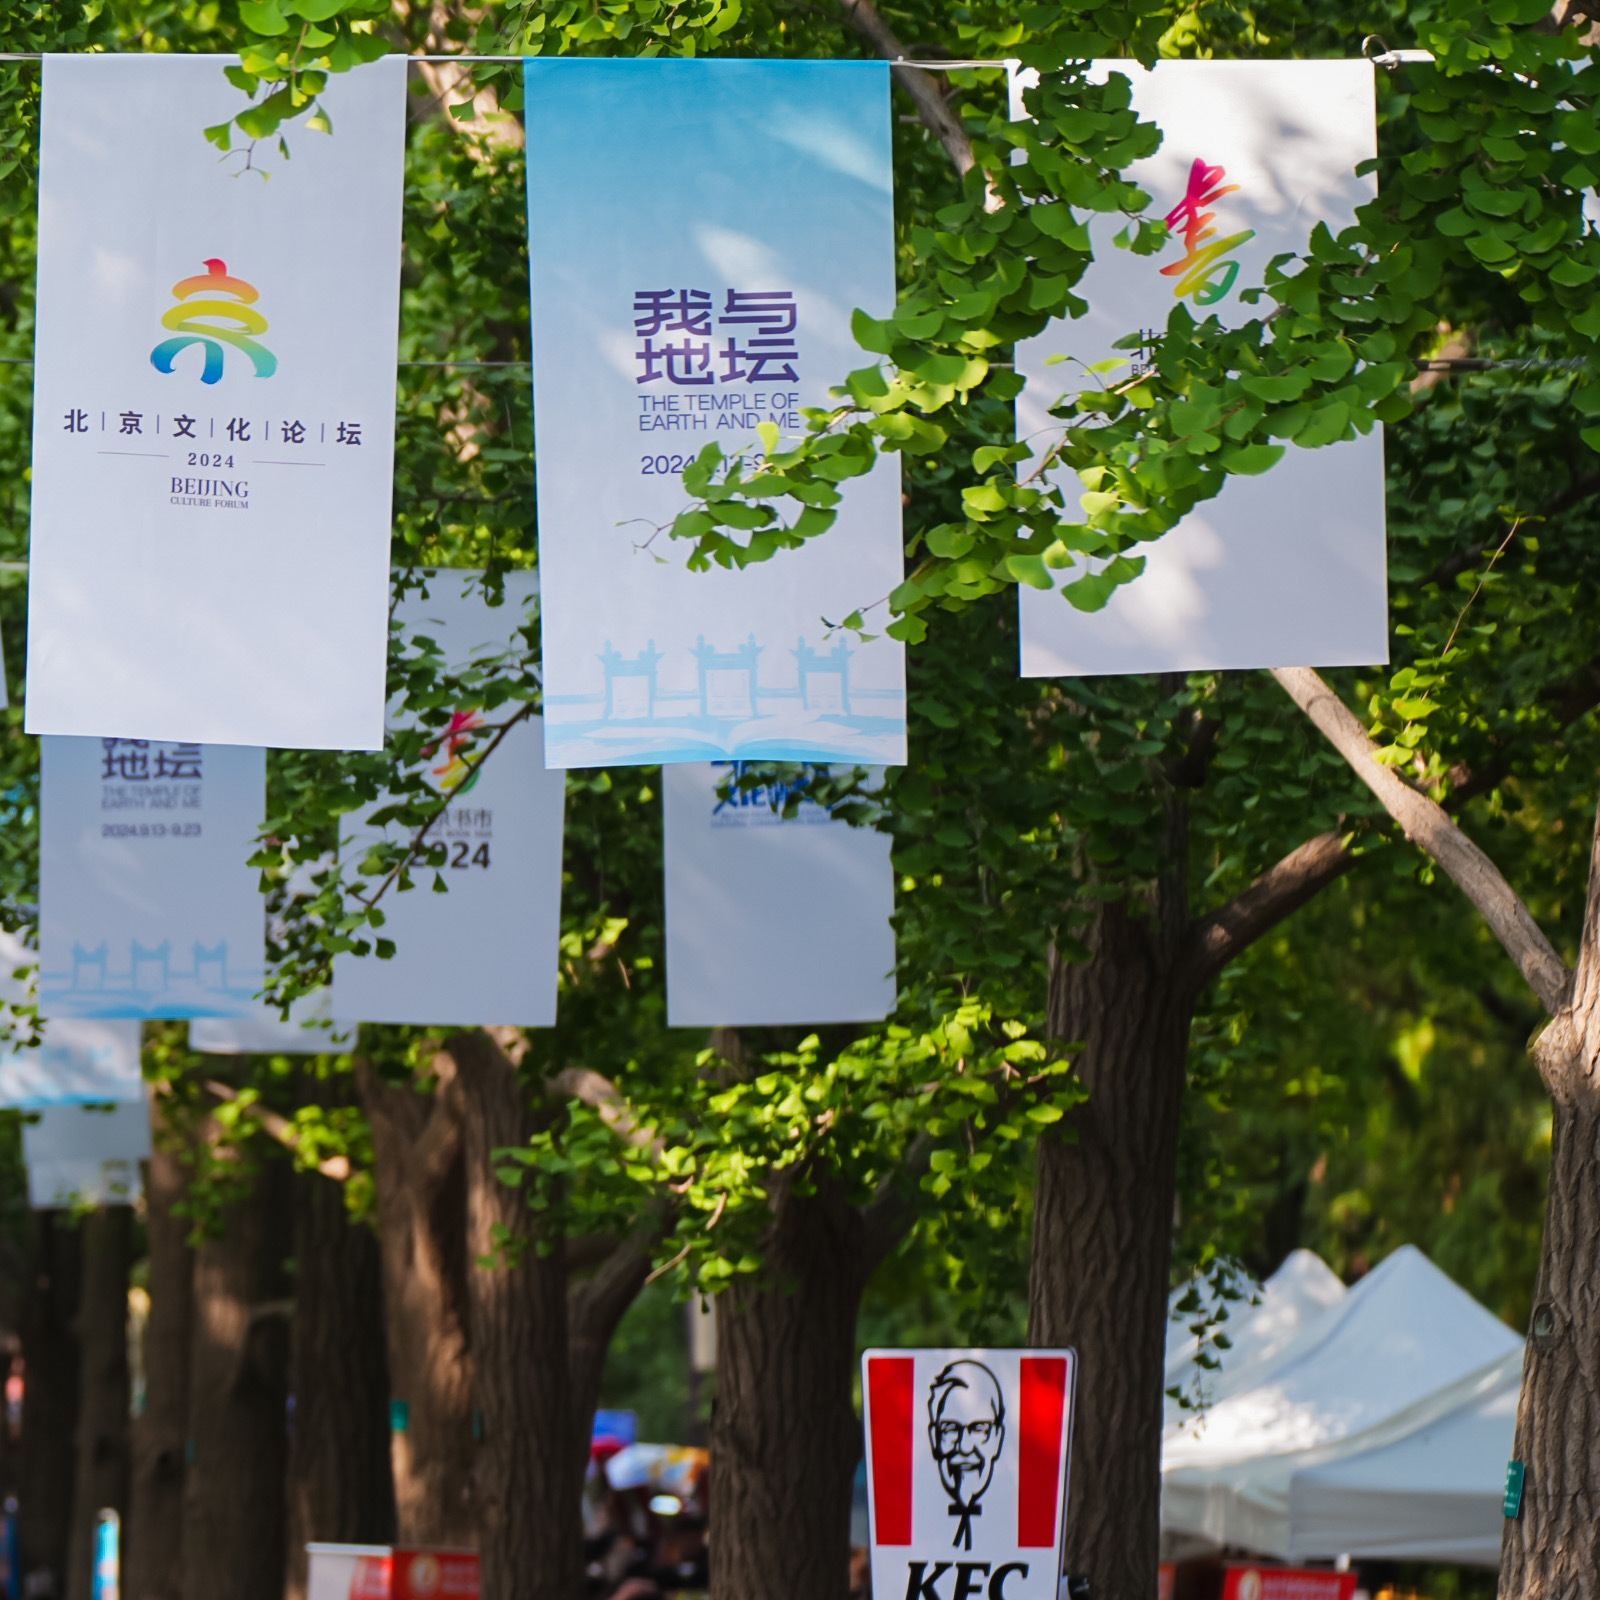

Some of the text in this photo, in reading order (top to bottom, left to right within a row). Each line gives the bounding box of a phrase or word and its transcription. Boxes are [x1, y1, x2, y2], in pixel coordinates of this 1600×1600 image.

[633, 288, 797, 337] 我与
[636, 337, 800, 385] 地坛
[638, 392, 799, 411] THE TEMPLE OF
[639, 412, 800, 431] EARTH AND ME
[187, 453, 235, 468] 2024
[170, 477, 249, 498] BEIJING
[170, 496, 249, 509] CULTURE FORUM
[102, 749, 203, 780] 地坛
